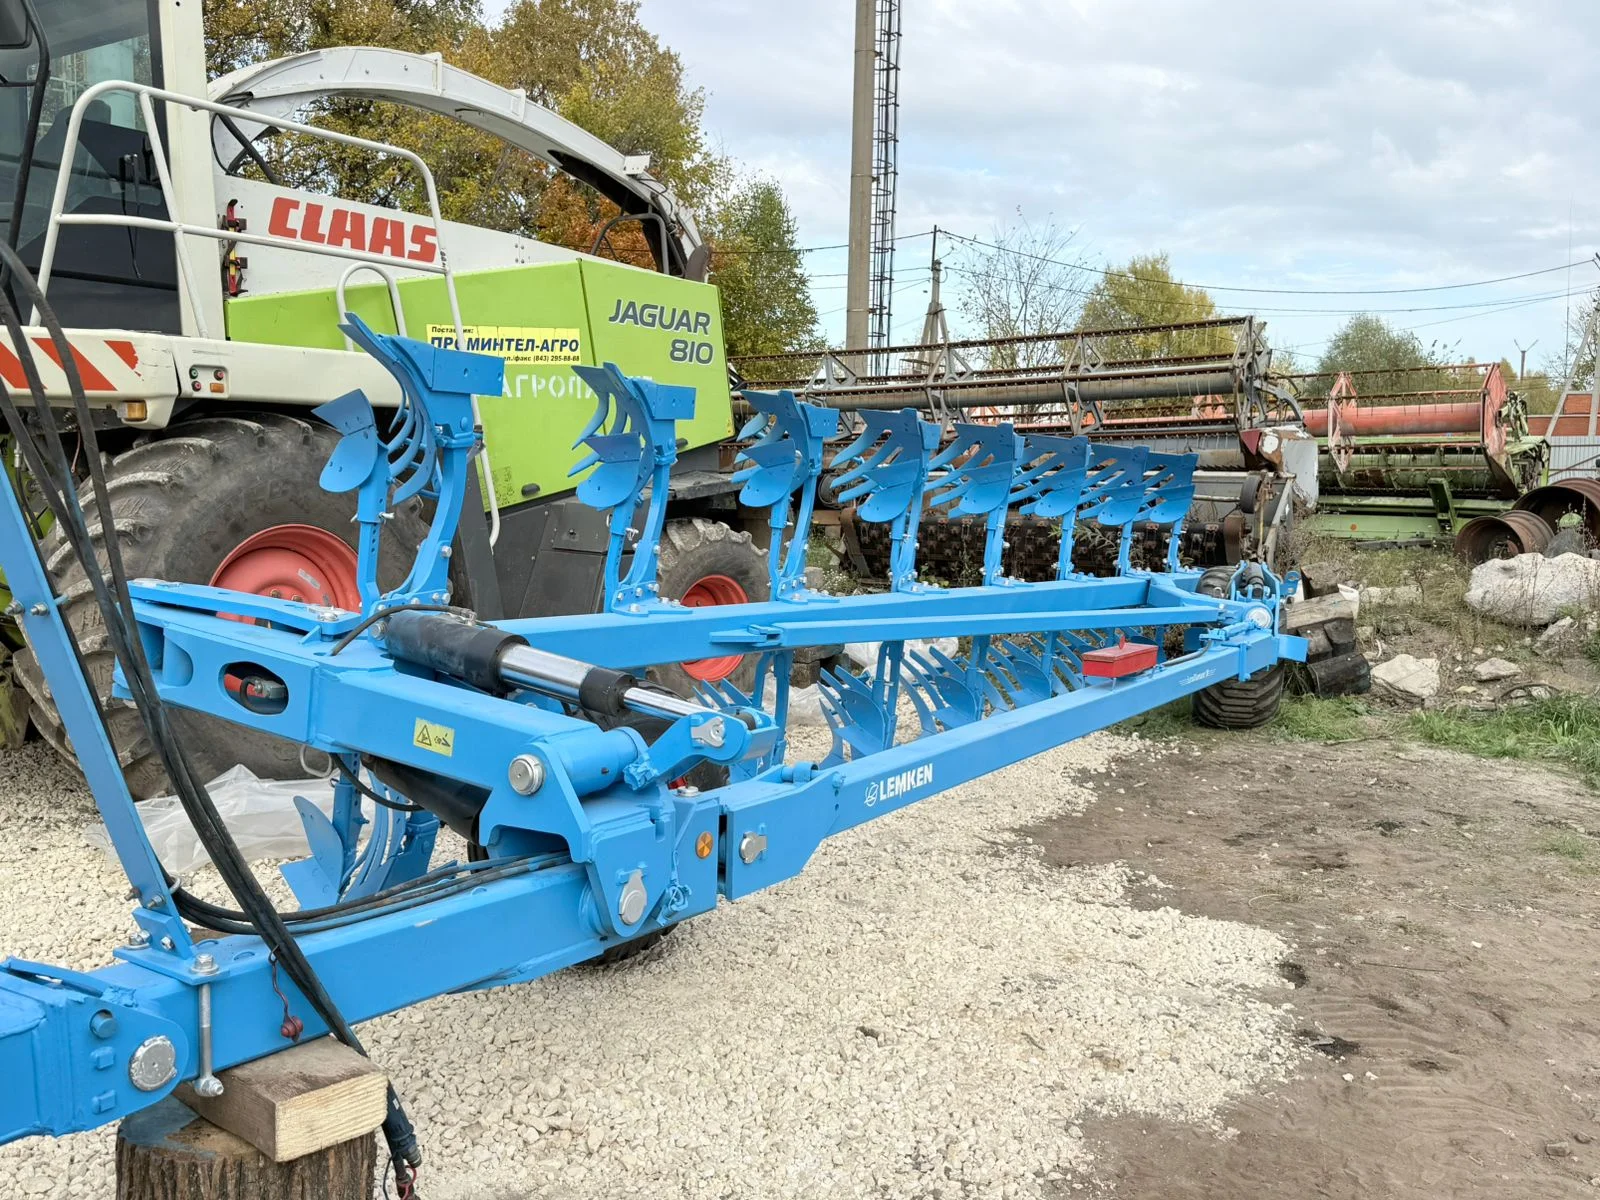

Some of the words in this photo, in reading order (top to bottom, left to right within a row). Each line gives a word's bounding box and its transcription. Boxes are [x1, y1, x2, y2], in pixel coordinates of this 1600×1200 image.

[268, 196, 437, 263] CLAAS
[608, 298, 711, 336] JAGUAR
[670, 338, 714, 365] 810
[879, 763, 933, 801] LEMKEN
